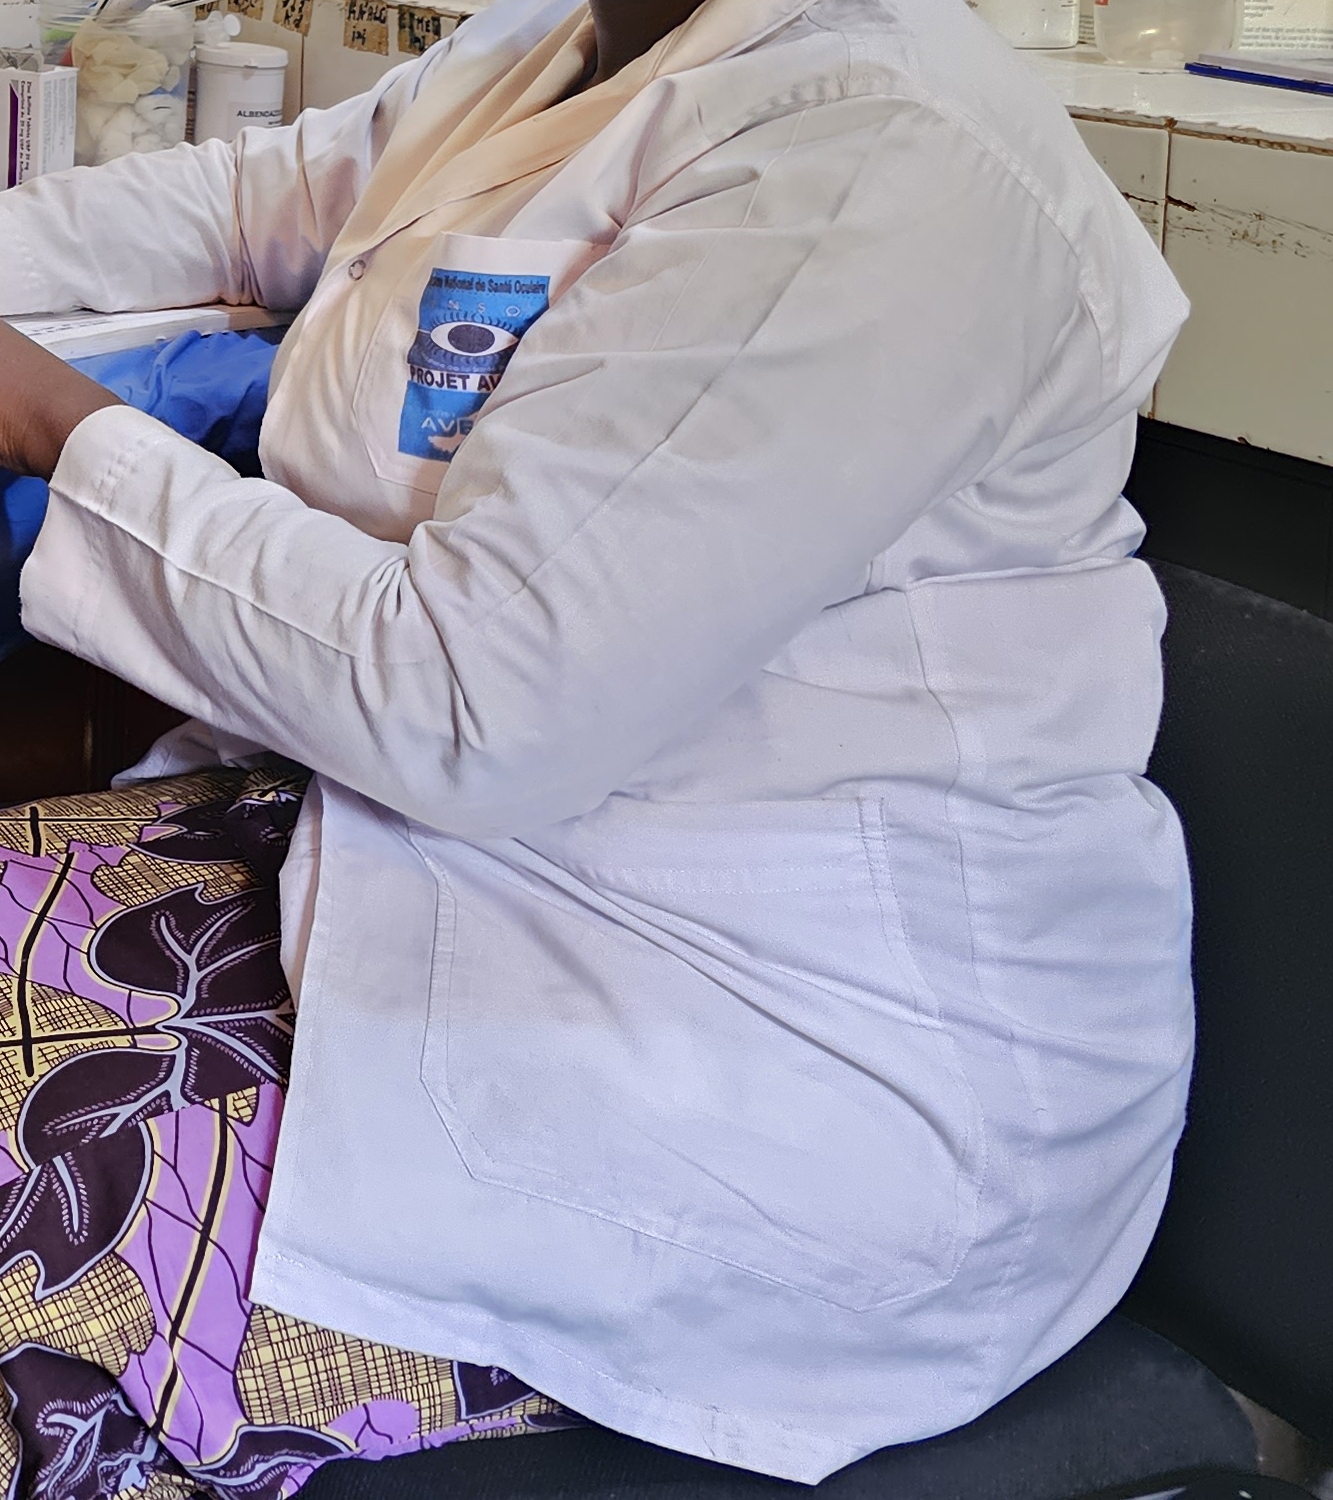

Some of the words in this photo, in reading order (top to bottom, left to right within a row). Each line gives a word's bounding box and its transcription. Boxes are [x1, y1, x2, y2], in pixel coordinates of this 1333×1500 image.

[475, 277, 486, 292] de
[487, 277, 513, 294] Santé
[477, 301, 486, 314] S
[409, 364, 470, 391] PROJET
